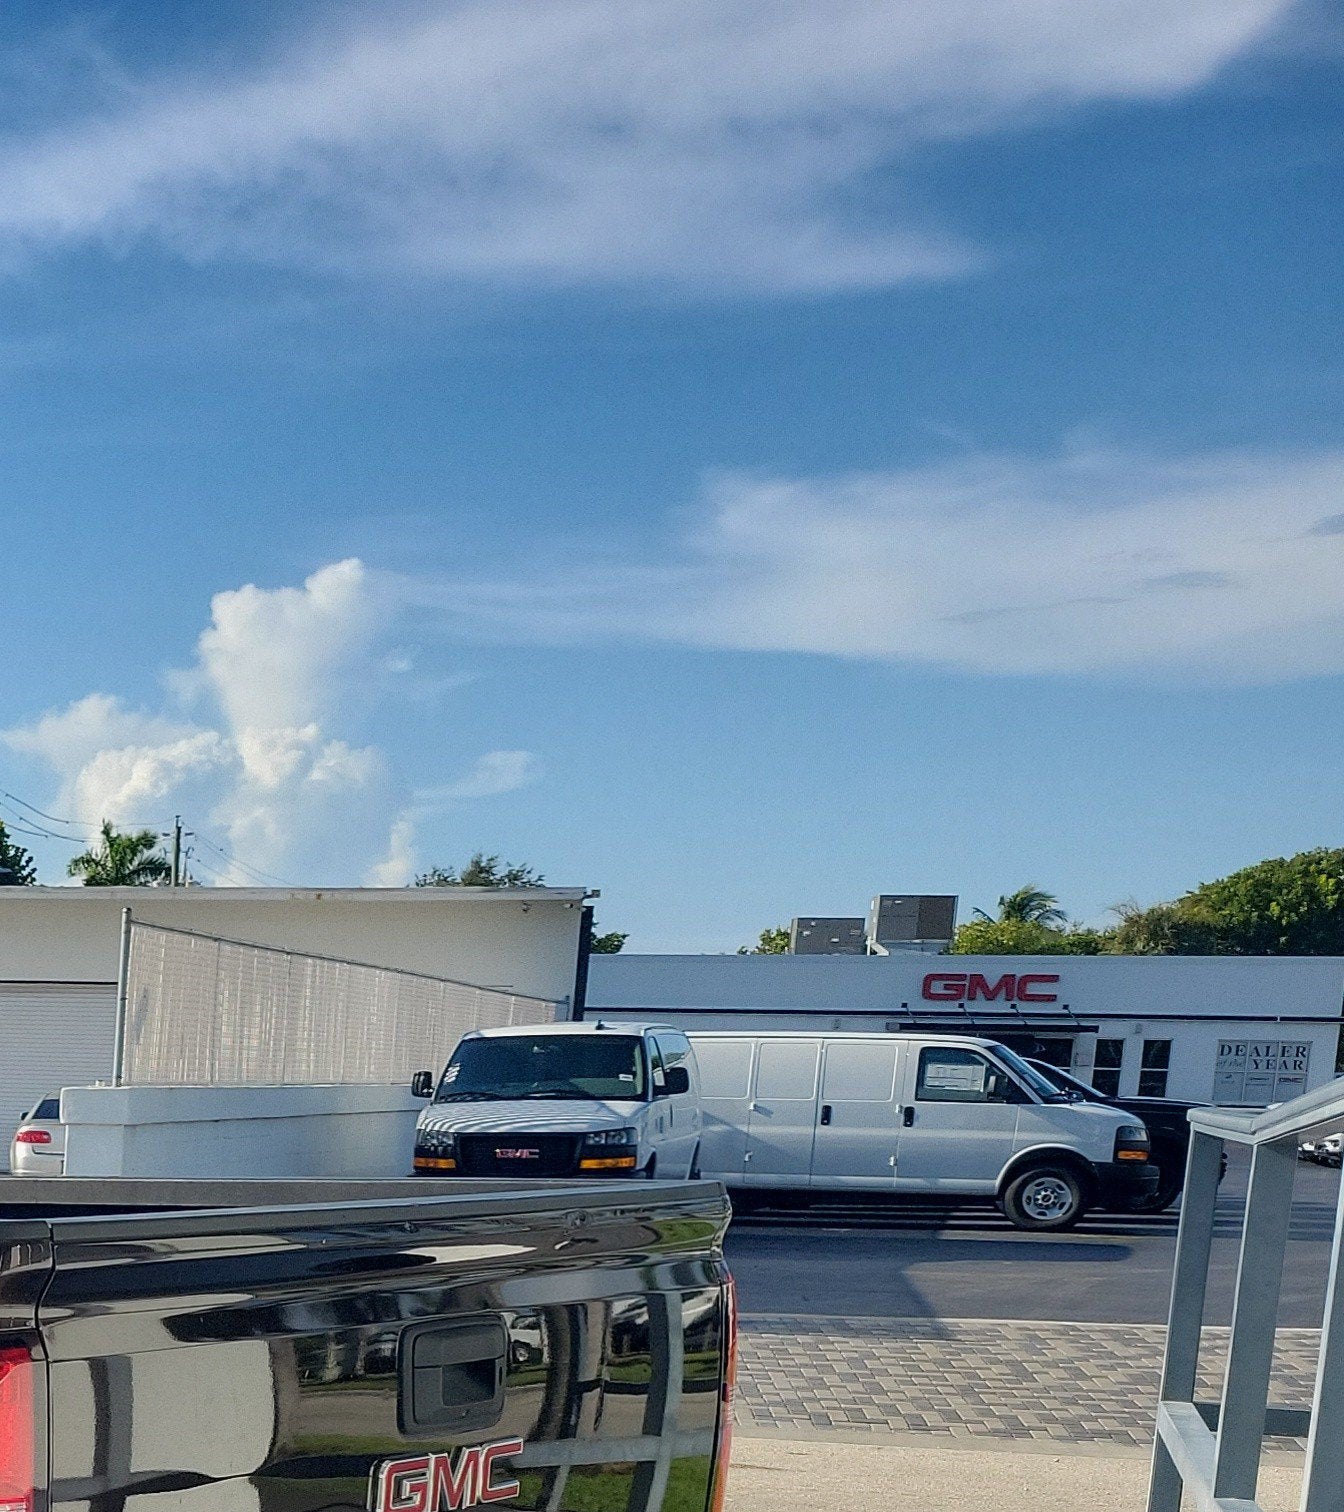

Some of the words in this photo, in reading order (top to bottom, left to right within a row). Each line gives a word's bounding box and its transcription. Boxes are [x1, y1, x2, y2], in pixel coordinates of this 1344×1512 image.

[922, 974, 1059, 1002] GMC
[1220, 1045, 1307, 1058] DEALER
[1252, 1060, 1303, 1070] YEAR
[495, 1149, 539, 1159] GMC
